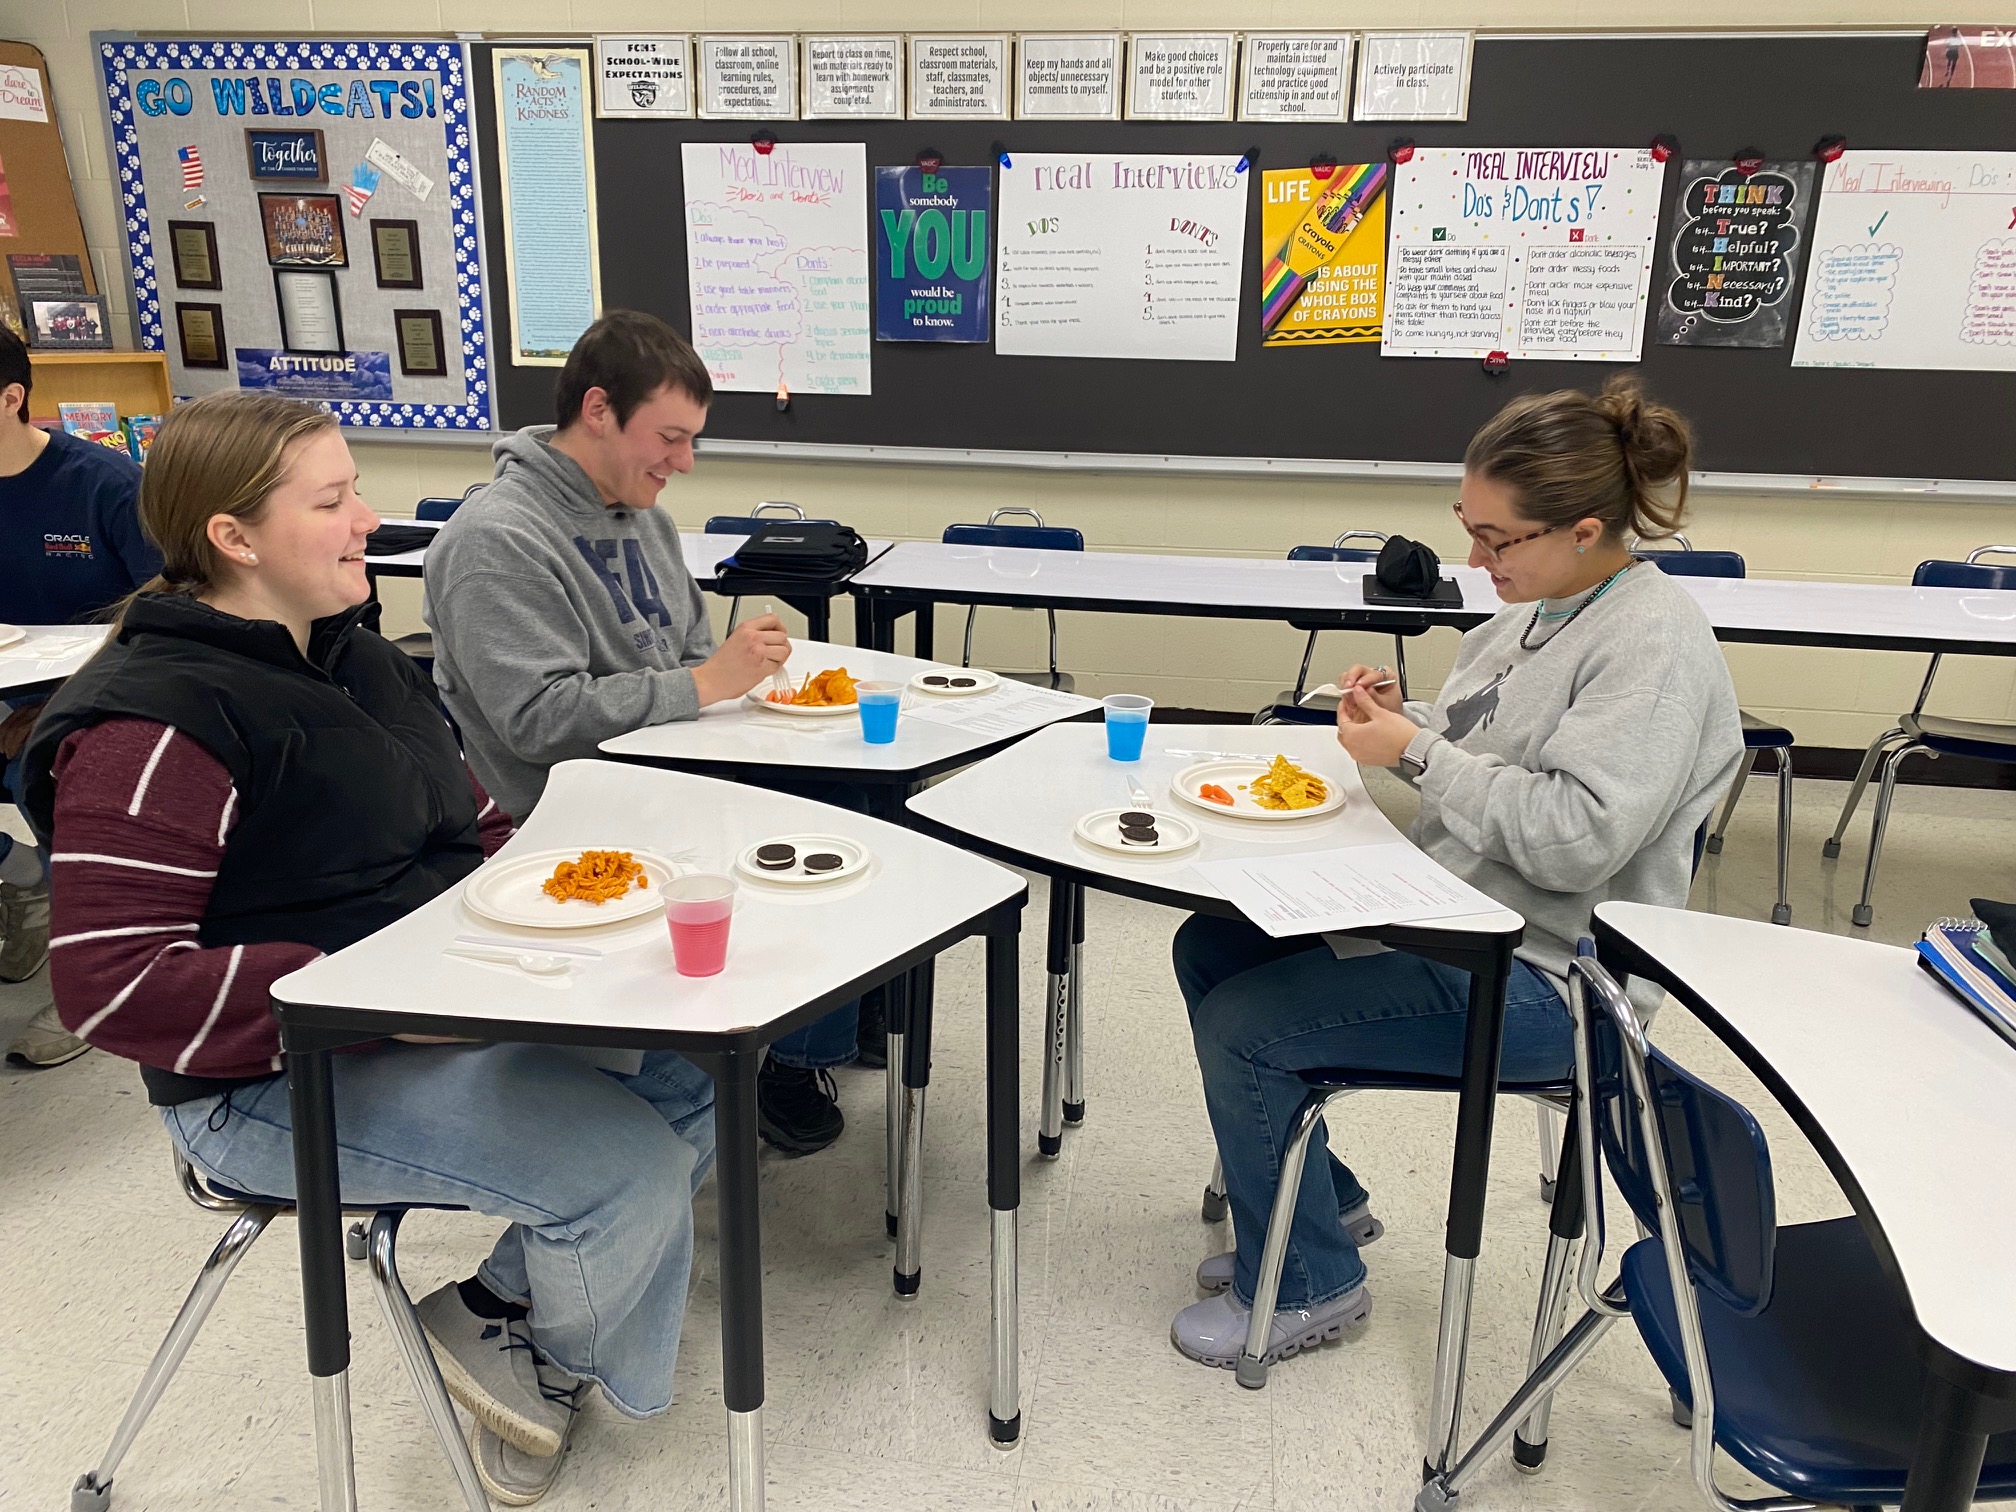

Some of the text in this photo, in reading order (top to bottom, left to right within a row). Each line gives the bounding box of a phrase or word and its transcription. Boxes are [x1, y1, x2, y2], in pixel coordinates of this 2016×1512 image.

[627, 44, 656, 52] FCHS
[716, 46, 777, 58] Follow all school,
[929, 46, 987, 58] Respect school,
[1258, 40, 1337, 52] Properly care for and
[812, 48, 893, 59] Report to class on time,
[1145, 50, 1218, 63] Make good choices
[1267, 53, 1326, 63] maintain issued
[715, 59, 779, 70] classroom, online
[920, 58, 998, 70] classroom materials,
[1027, 58, 1111, 70] Keep my hands and all
[1139, 63, 1222, 76] and be a positive role
[1374, 63, 1454, 76] Actively participate
[605, 70, 683, 79] EXPECTATIONS
[721, 71, 773, 83] learning rules,
[926, 71, 991, 83] staff, classmates,
[1029, 70, 1109, 83] objects/ unnecessary
[1254, 65, 1338, 77] technology equipment
[4, 75, 26, 90] dare
[1150, 76, 1211, 87] model for other
[1262, 77, 1328, 90] and practice good
[1396, 77, 1429, 87] in class.
[516, 83, 567, 98] RANDOM
[718, 84, 777, 95] procedures, and
[933, 84, 983, 95] teachers, and
[1029, 83, 1108, 96] comments to myself.
[1161, 89, 1197, 100] students.
[1250, 89, 1339, 101] citizenship in and out of
[136, 76, 437, 119] GO WILDCATS!
[530, 96, 553, 106] ACTS
[724, 96, 772, 108] expectations.
[929, 96, 987, 107] administrators.
[1280, 102, 1306, 112] school.
[518, 107, 569, 121] KINDNESS
[253, 138, 318, 171] together
[720, 147, 843, 193] Meal Interview
[1466, 151, 1609, 180] MEAL INTERVIEW
[1112, 161, 1238, 190] Interviews
[1830, 162, 1865, 192] Meal
[922, 173, 949, 193] Be
[770, 191, 784, 201] and
[1268, 179, 1311, 203] LIFE
[1703, 184, 1785, 204] THINK
[909, 195, 958, 209] somebody
[1702, 205, 1732, 215] before
[1733, 207, 1750, 216] you
[1695, 226, 1702, 235] Is
[1716, 218, 1768, 235] True?
[1302, 222, 1335, 252] Crayola
[1447, 233, 1456, 241] Do
[880, 209, 986, 281] YOU
[1297, 236, 1326, 260] CRAYONS
[1692, 245, 1698, 253] Is
[1712, 236, 1779, 256] Helpful?
[1403, 256, 1422, 264] messy
[1689, 263, 1696, 271] Is
[1713, 255, 1782, 272] IMPORTANT?
[1317, 263, 1379, 279] IS ABOUT
[1307, 278, 1378, 292] USING THE
[1686, 281, 1693, 289] Is
[1706, 273, 1785, 295] Necessary?
[911, 286, 955, 297] would be
[1300, 293, 1378, 307] WHOLE BOX
[1684, 299, 1691, 307] Is
[1704, 291, 1753, 308] Kind?
[904, 294, 962, 319] proud
[1293, 306, 1377, 322] OF CRAYONS
[913, 316, 954, 327] to know.
[269, 356, 356, 372] ATTITUDE
[64, 412, 113, 422] MEMORY
[44, 534, 90, 544] ORACLE
